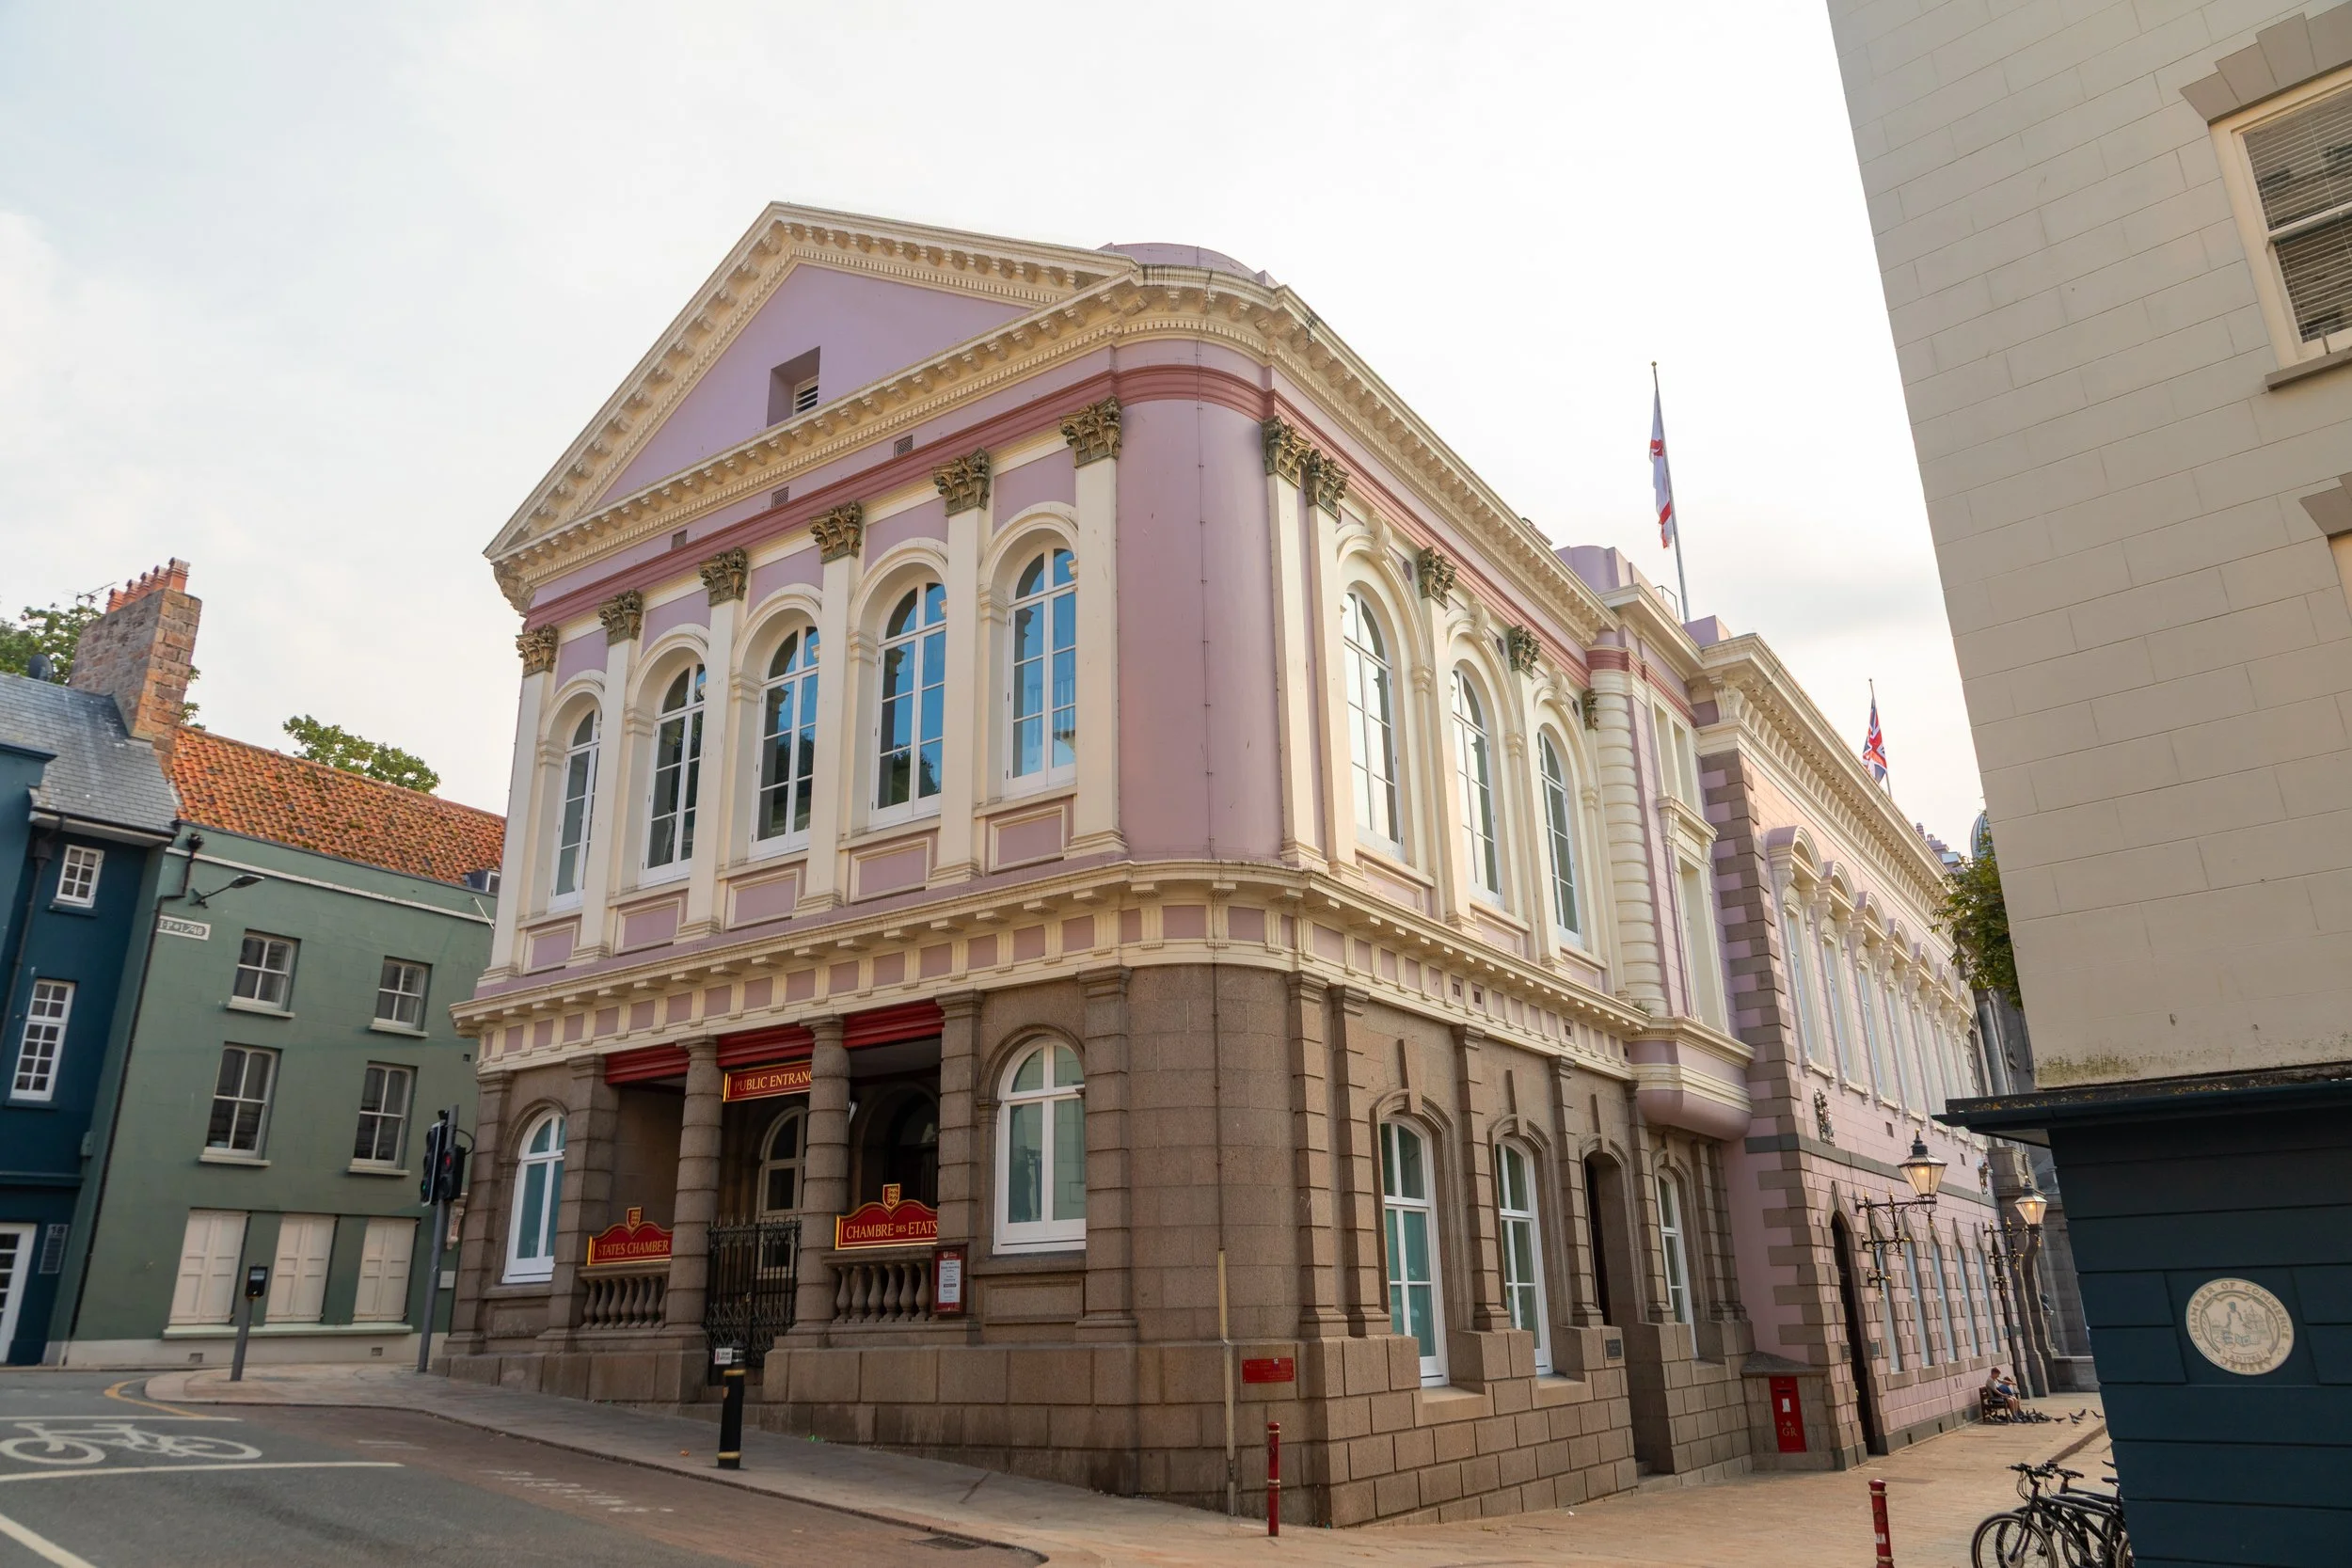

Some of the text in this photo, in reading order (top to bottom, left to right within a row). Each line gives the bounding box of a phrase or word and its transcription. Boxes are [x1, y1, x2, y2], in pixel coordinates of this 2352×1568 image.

[735, 1070, 813, 1092] PUBLIC ENTRANC
[847, 1220, 938, 1240] CHAMBRE DES ETATS
[598, 1240, 669, 1257] STATES CHAMBER
[2220, 1281, 2236, 1291] OF
